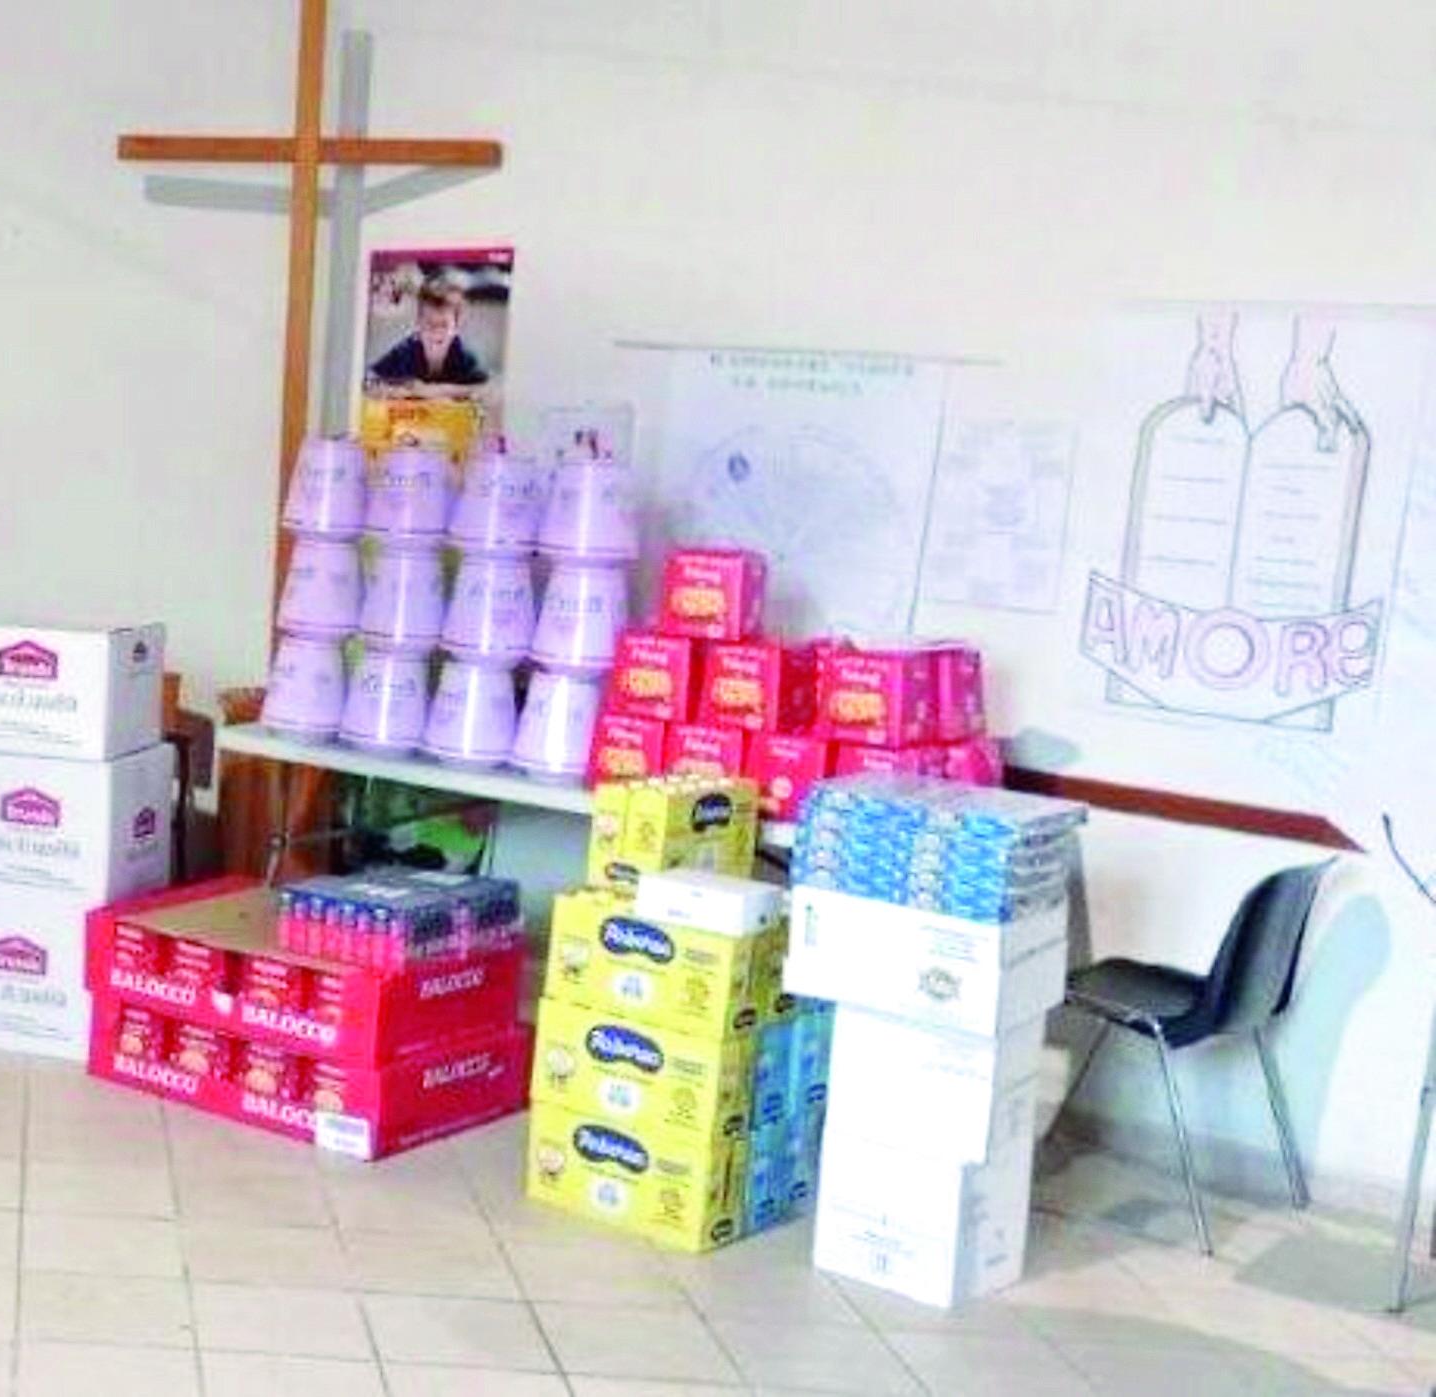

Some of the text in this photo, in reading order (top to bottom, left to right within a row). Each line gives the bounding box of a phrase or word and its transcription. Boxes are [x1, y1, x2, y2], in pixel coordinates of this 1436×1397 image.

[109, 967, 196, 1006] BALOCCO
[241, 1004, 337, 1046] BALOCCO
[114, 1053, 198, 1095] BALOCCO
